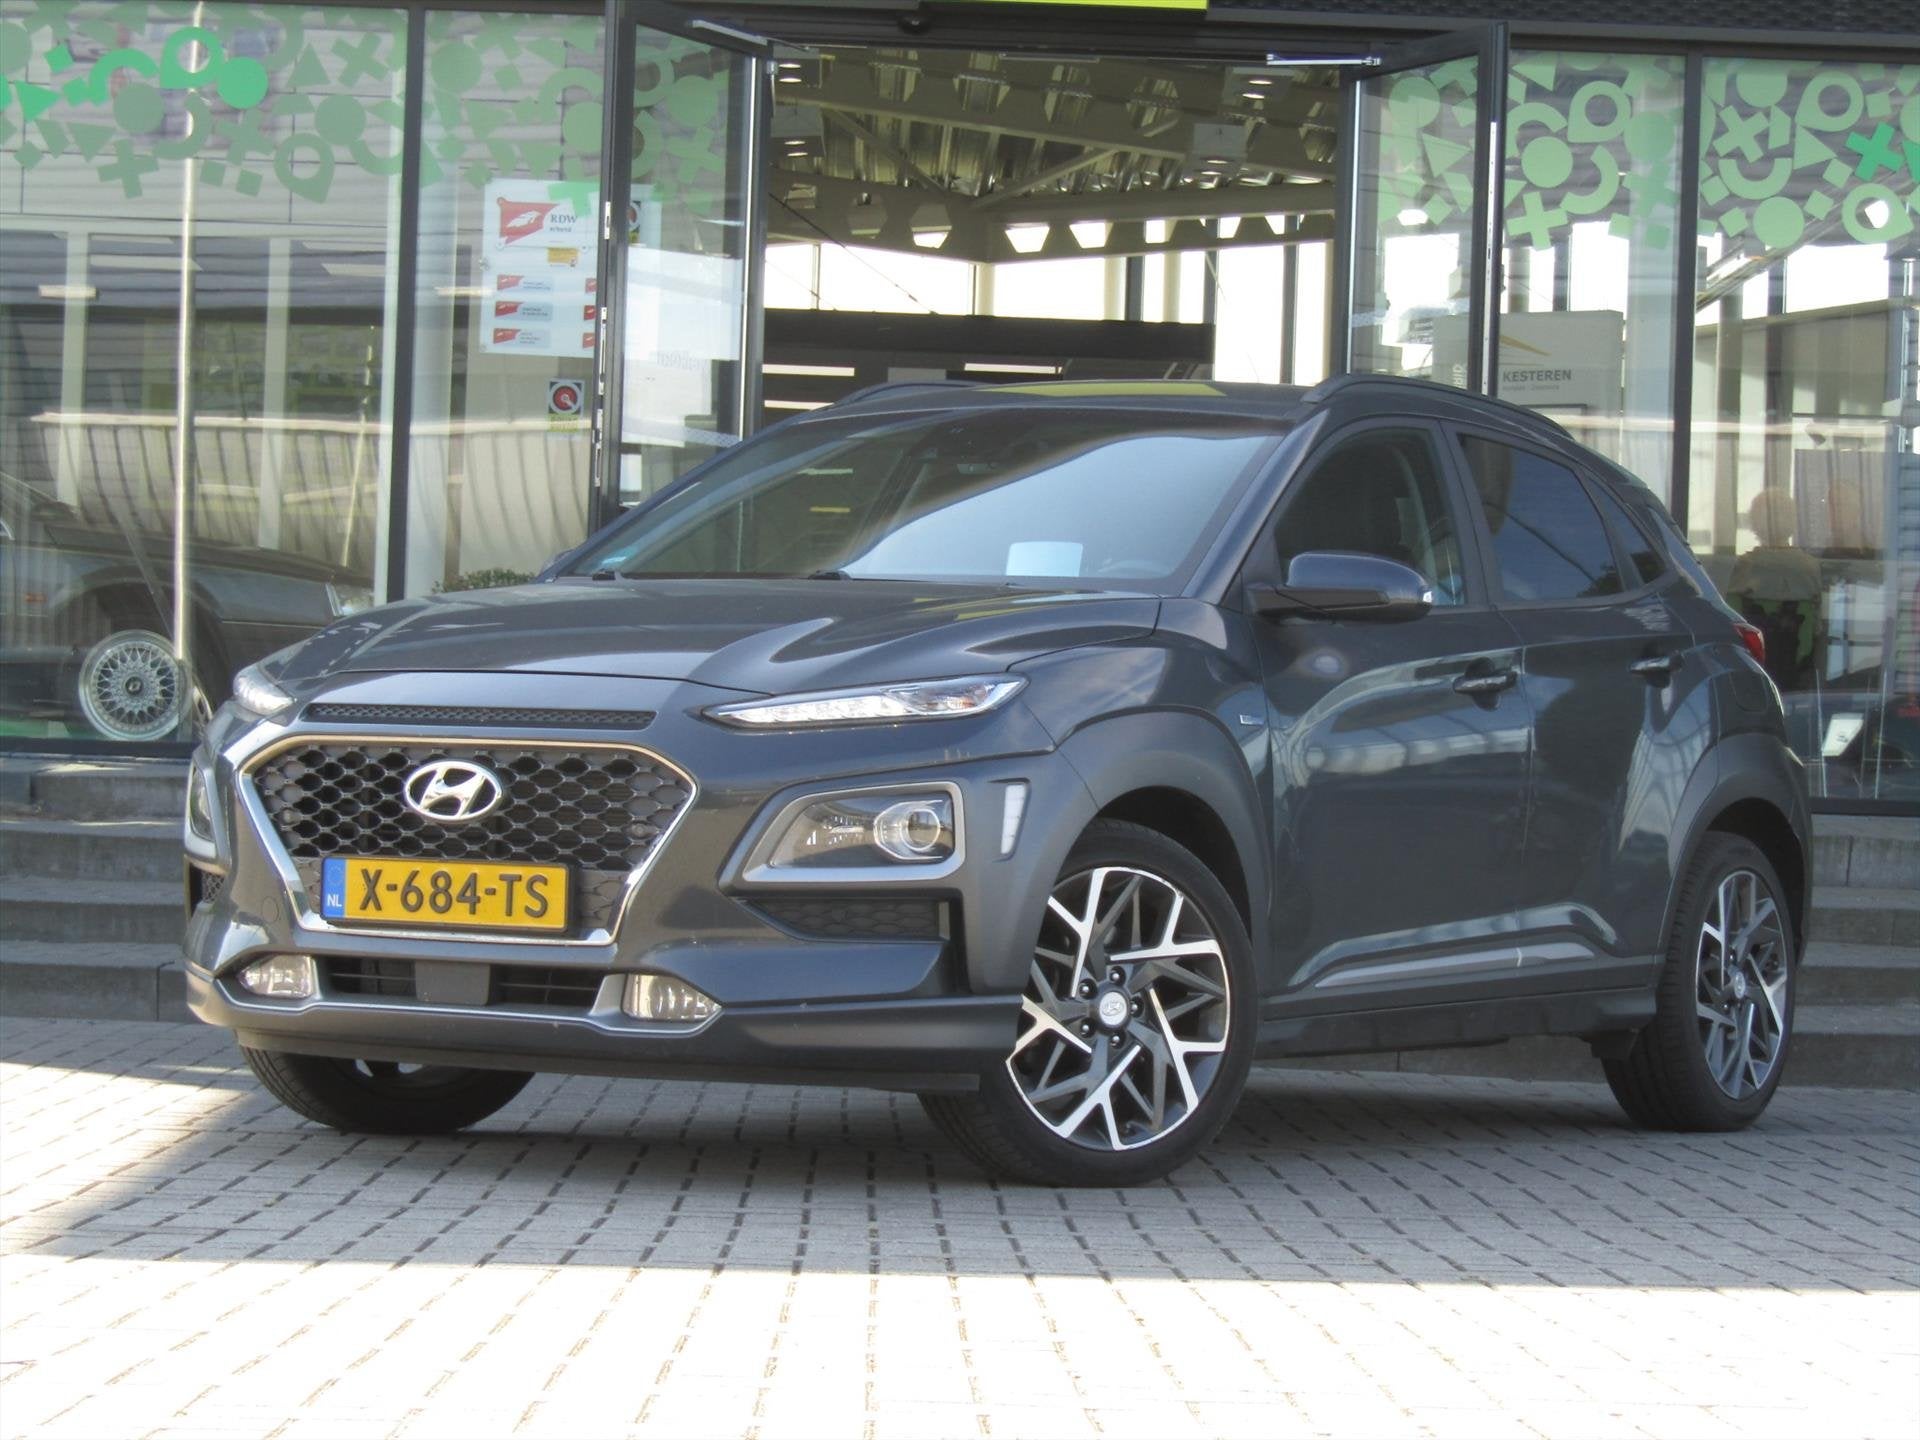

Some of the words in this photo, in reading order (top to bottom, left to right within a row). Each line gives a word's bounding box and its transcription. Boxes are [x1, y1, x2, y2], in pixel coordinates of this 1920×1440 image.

[550, 213, 578, 224] RDW
[1502, 369, 1572, 383] KESTEREN
[359, 868, 549, 918] X-684-TS
[326, 893, 343, 908] NL
